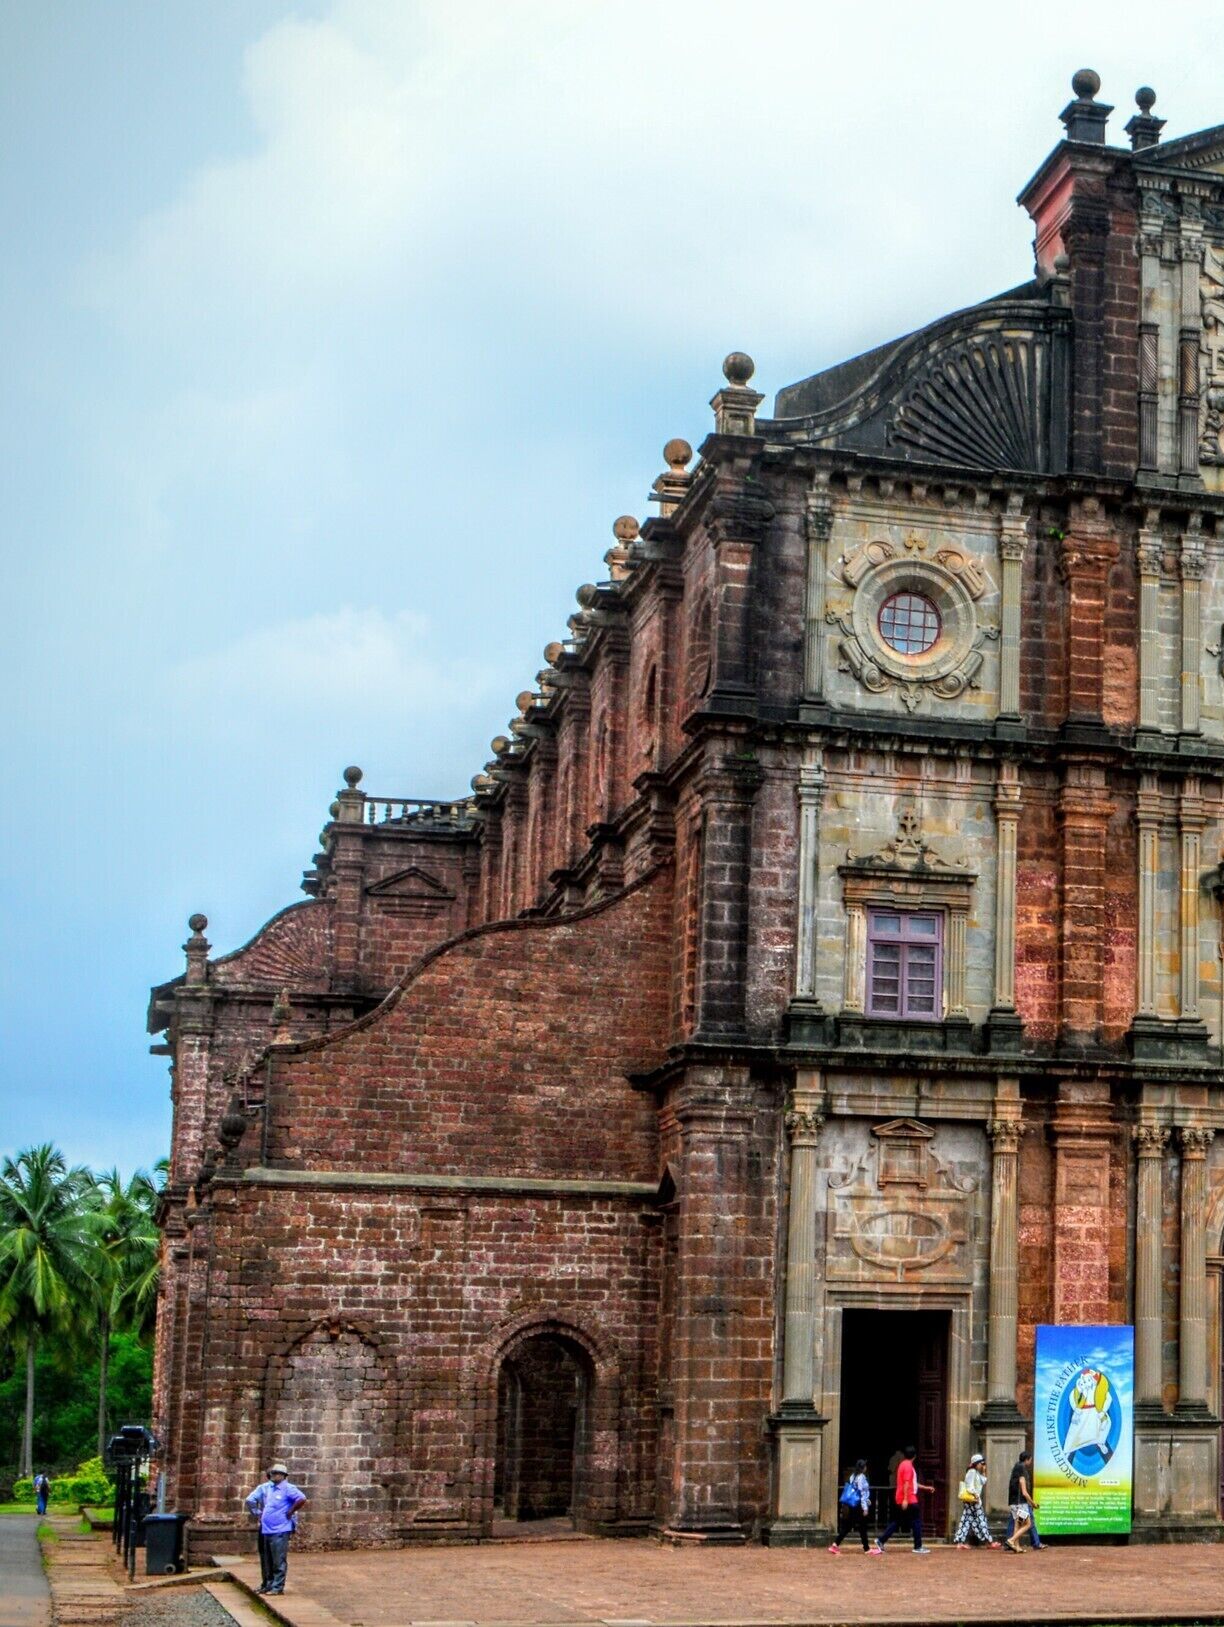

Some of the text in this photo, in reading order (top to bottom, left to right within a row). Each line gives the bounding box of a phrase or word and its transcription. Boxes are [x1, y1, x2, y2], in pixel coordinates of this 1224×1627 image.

[1046, 1355, 1089, 1488] MERCIFUL LIKE THE FATHER
